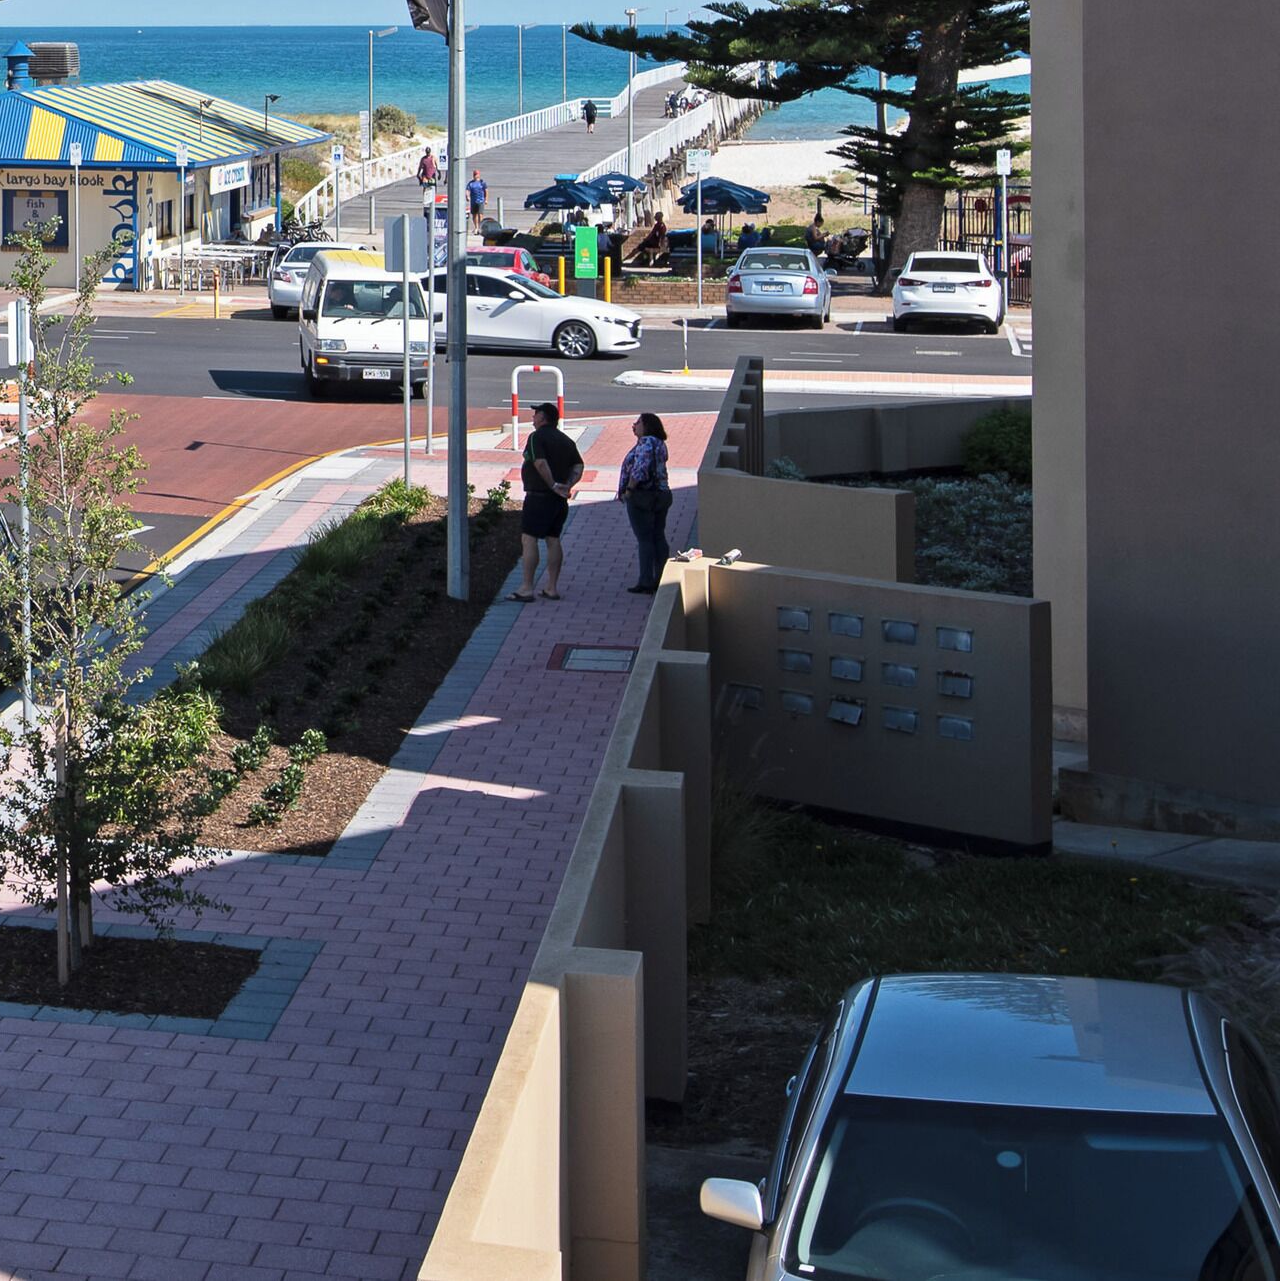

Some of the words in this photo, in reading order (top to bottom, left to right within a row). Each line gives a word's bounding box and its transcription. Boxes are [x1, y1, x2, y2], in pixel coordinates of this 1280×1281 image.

[6, 173, 40, 187] largs
[43, 173, 67, 188] bay
[70, 173, 104, 187] kiosk
[26, 198, 45, 208] fish
[32, 209, 39, 218] &
